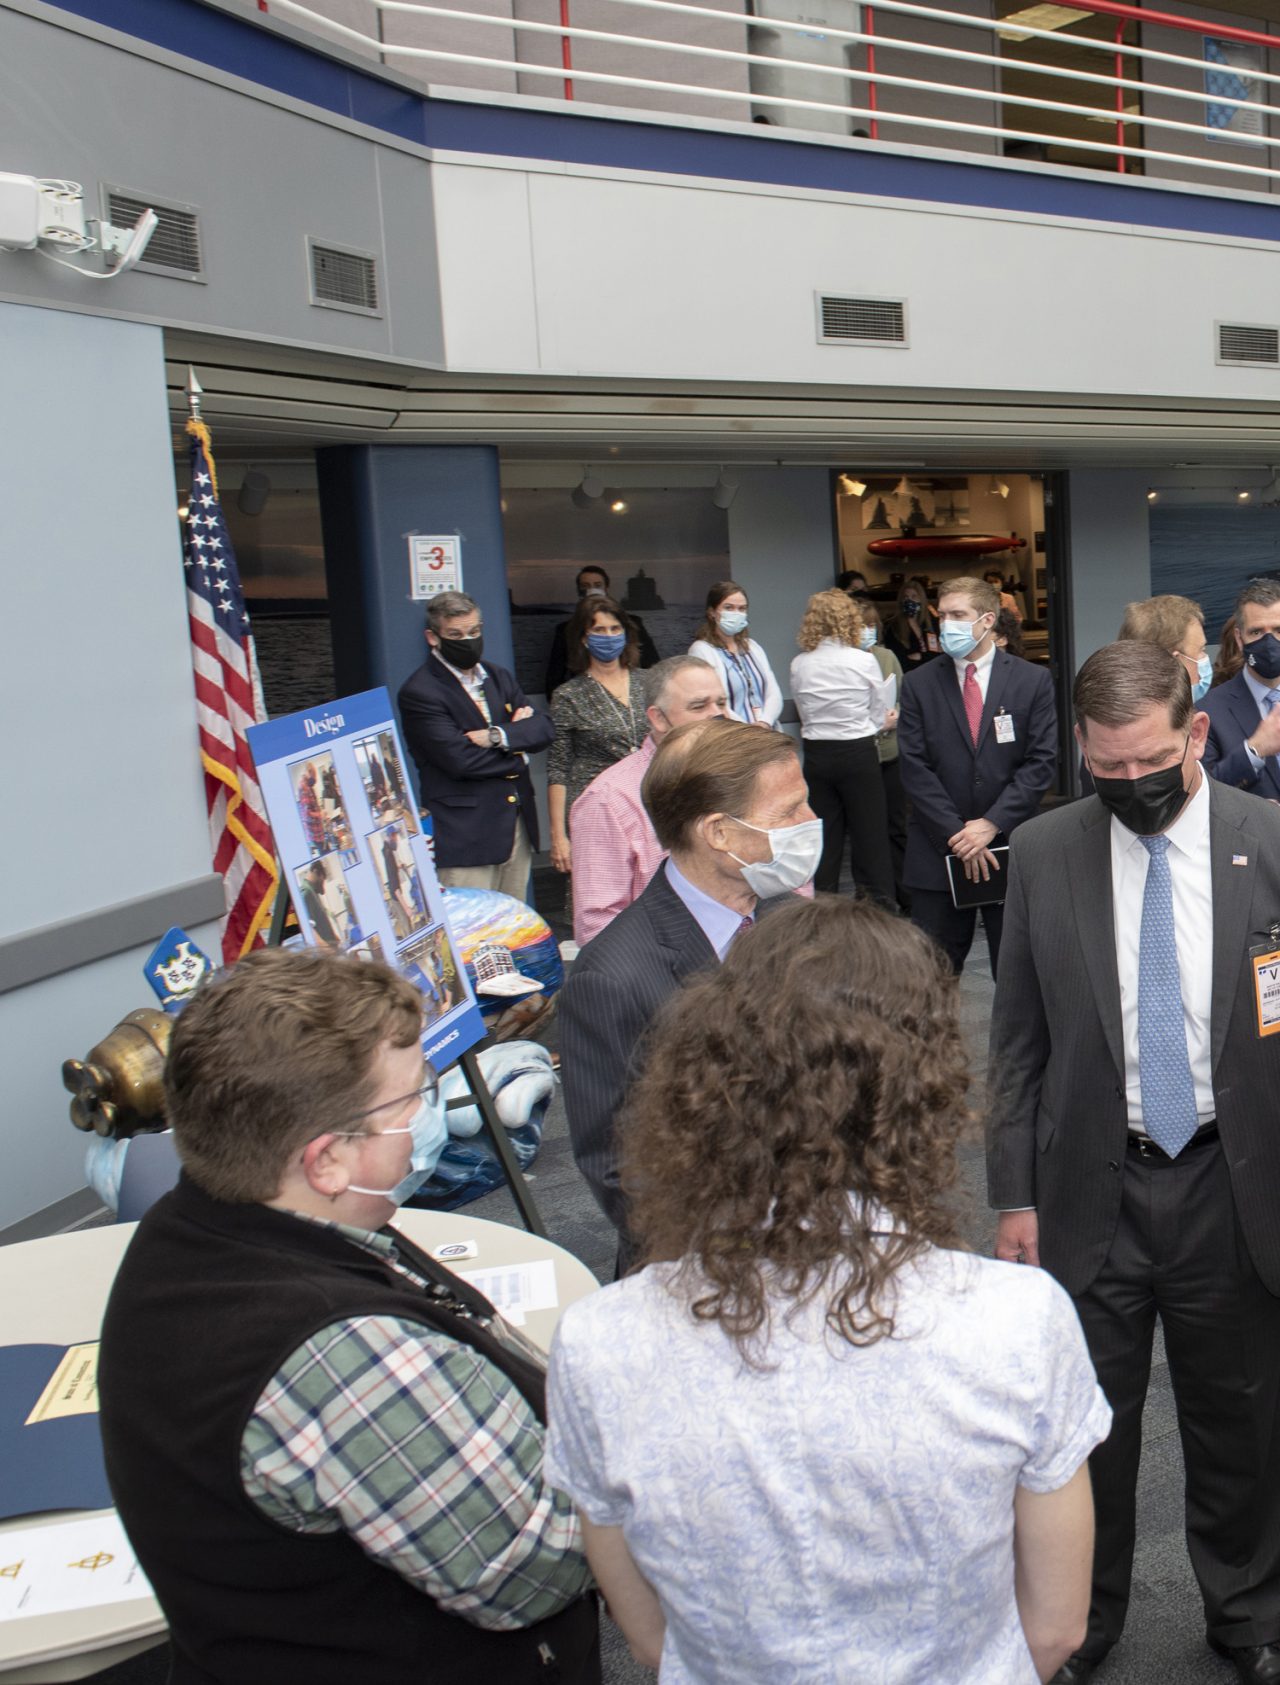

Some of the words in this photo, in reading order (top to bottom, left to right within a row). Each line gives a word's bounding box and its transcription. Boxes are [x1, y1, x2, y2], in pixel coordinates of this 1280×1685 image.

[429, 546, 444, 570] 3
[303, 712, 345, 738] Design
[1270, 968, 1278, 980] V
